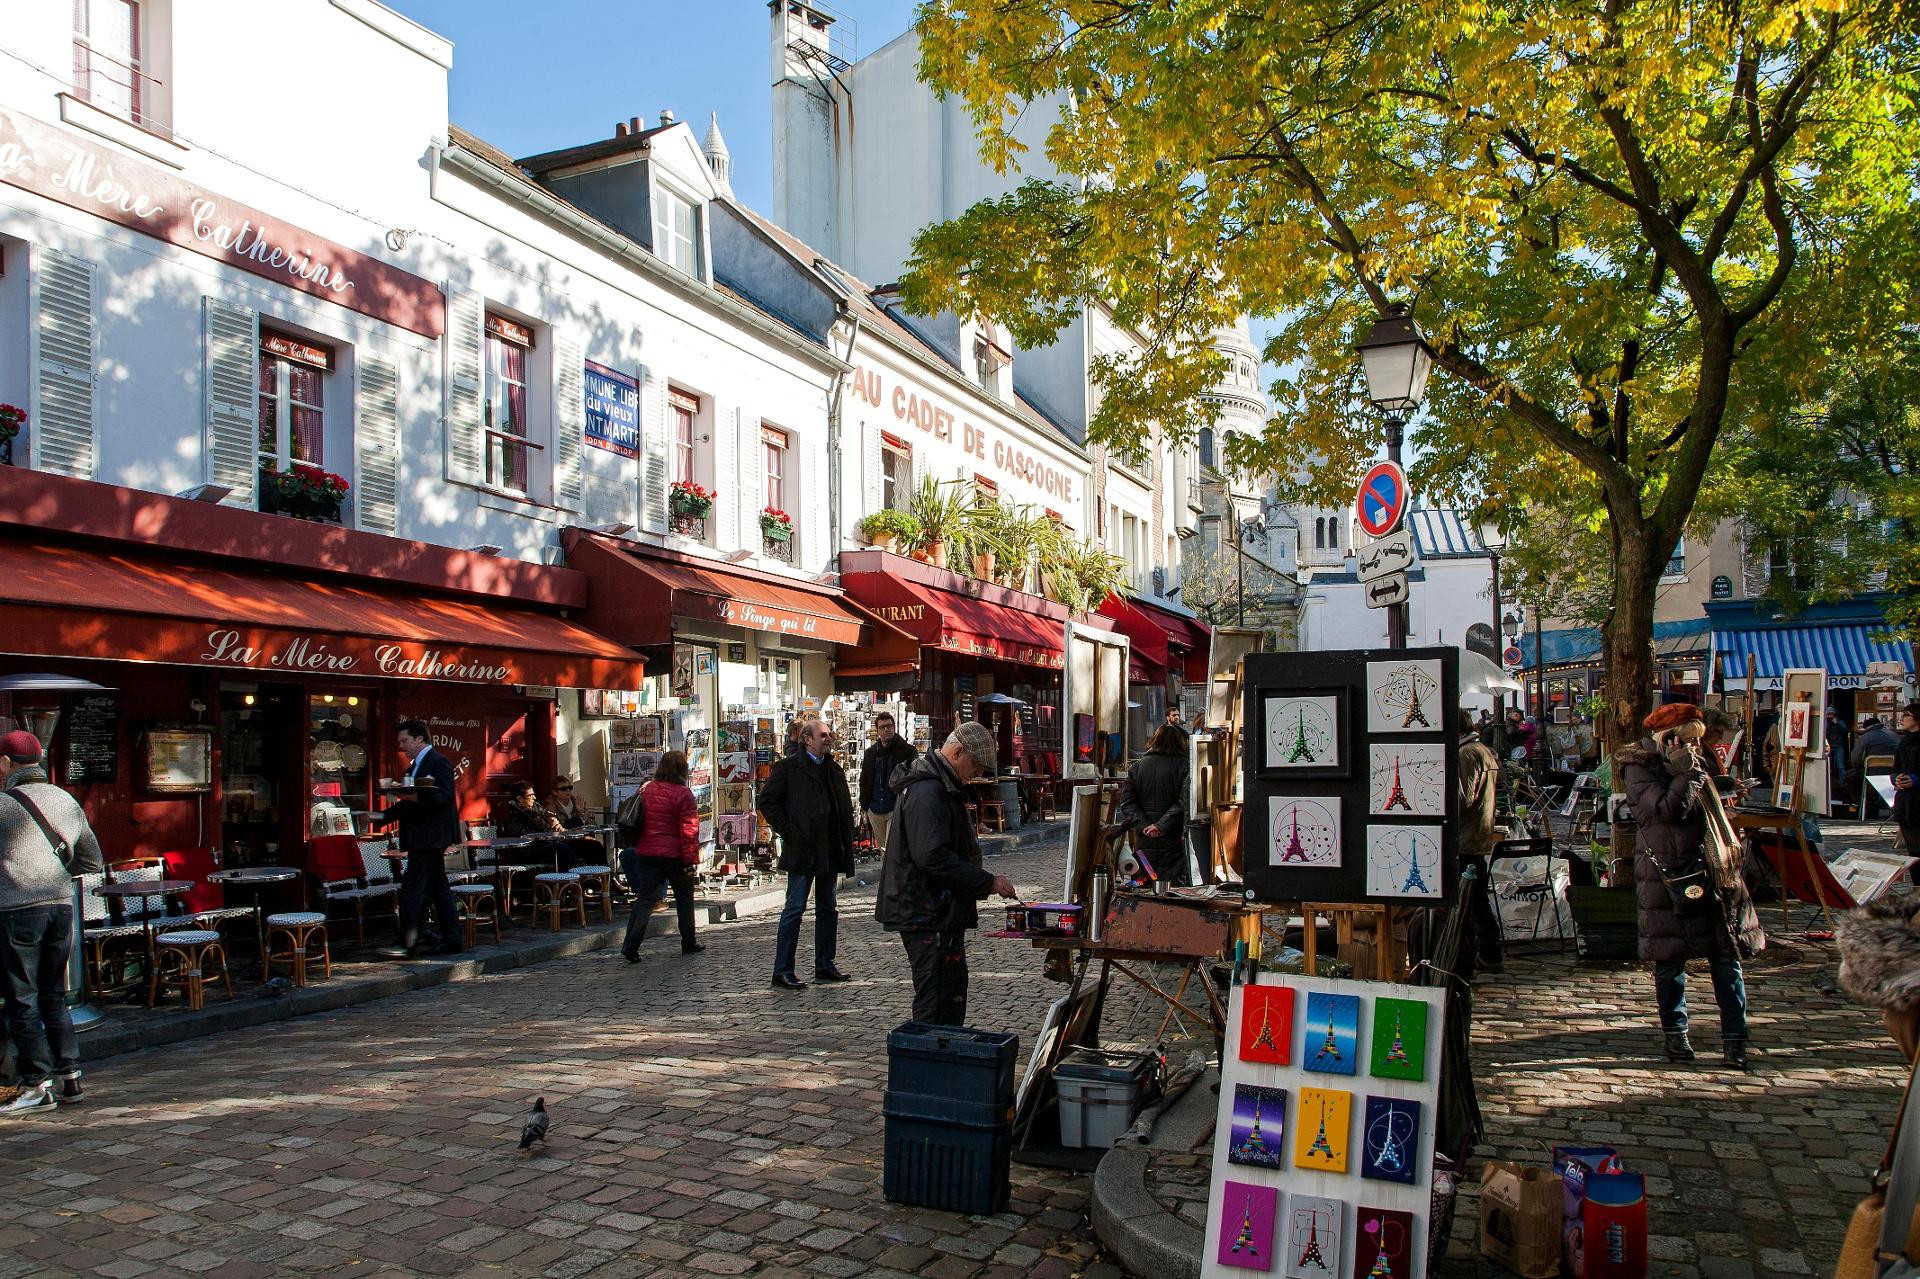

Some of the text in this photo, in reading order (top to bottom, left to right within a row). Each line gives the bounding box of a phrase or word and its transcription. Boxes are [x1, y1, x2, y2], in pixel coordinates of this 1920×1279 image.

[51, 143, 164, 218] Mère
[191, 198, 355, 293] Catherine
[585, 375, 617, 401] MUNE
[587, 393, 634, 424] du vieux
[853, 365, 881, 408] AU
[892, 385, 955, 444] CADET
[963, 422, 985, 461] DE
[994, 439, 1072, 504] GASCOGNE
[717, 600, 735, 619] Le
[201, 630, 261, 663] La
[374, 644, 513, 680] Catherine
[1829, 677, 1859, 686] RON
[432, 735, 462, 752] RDIN
